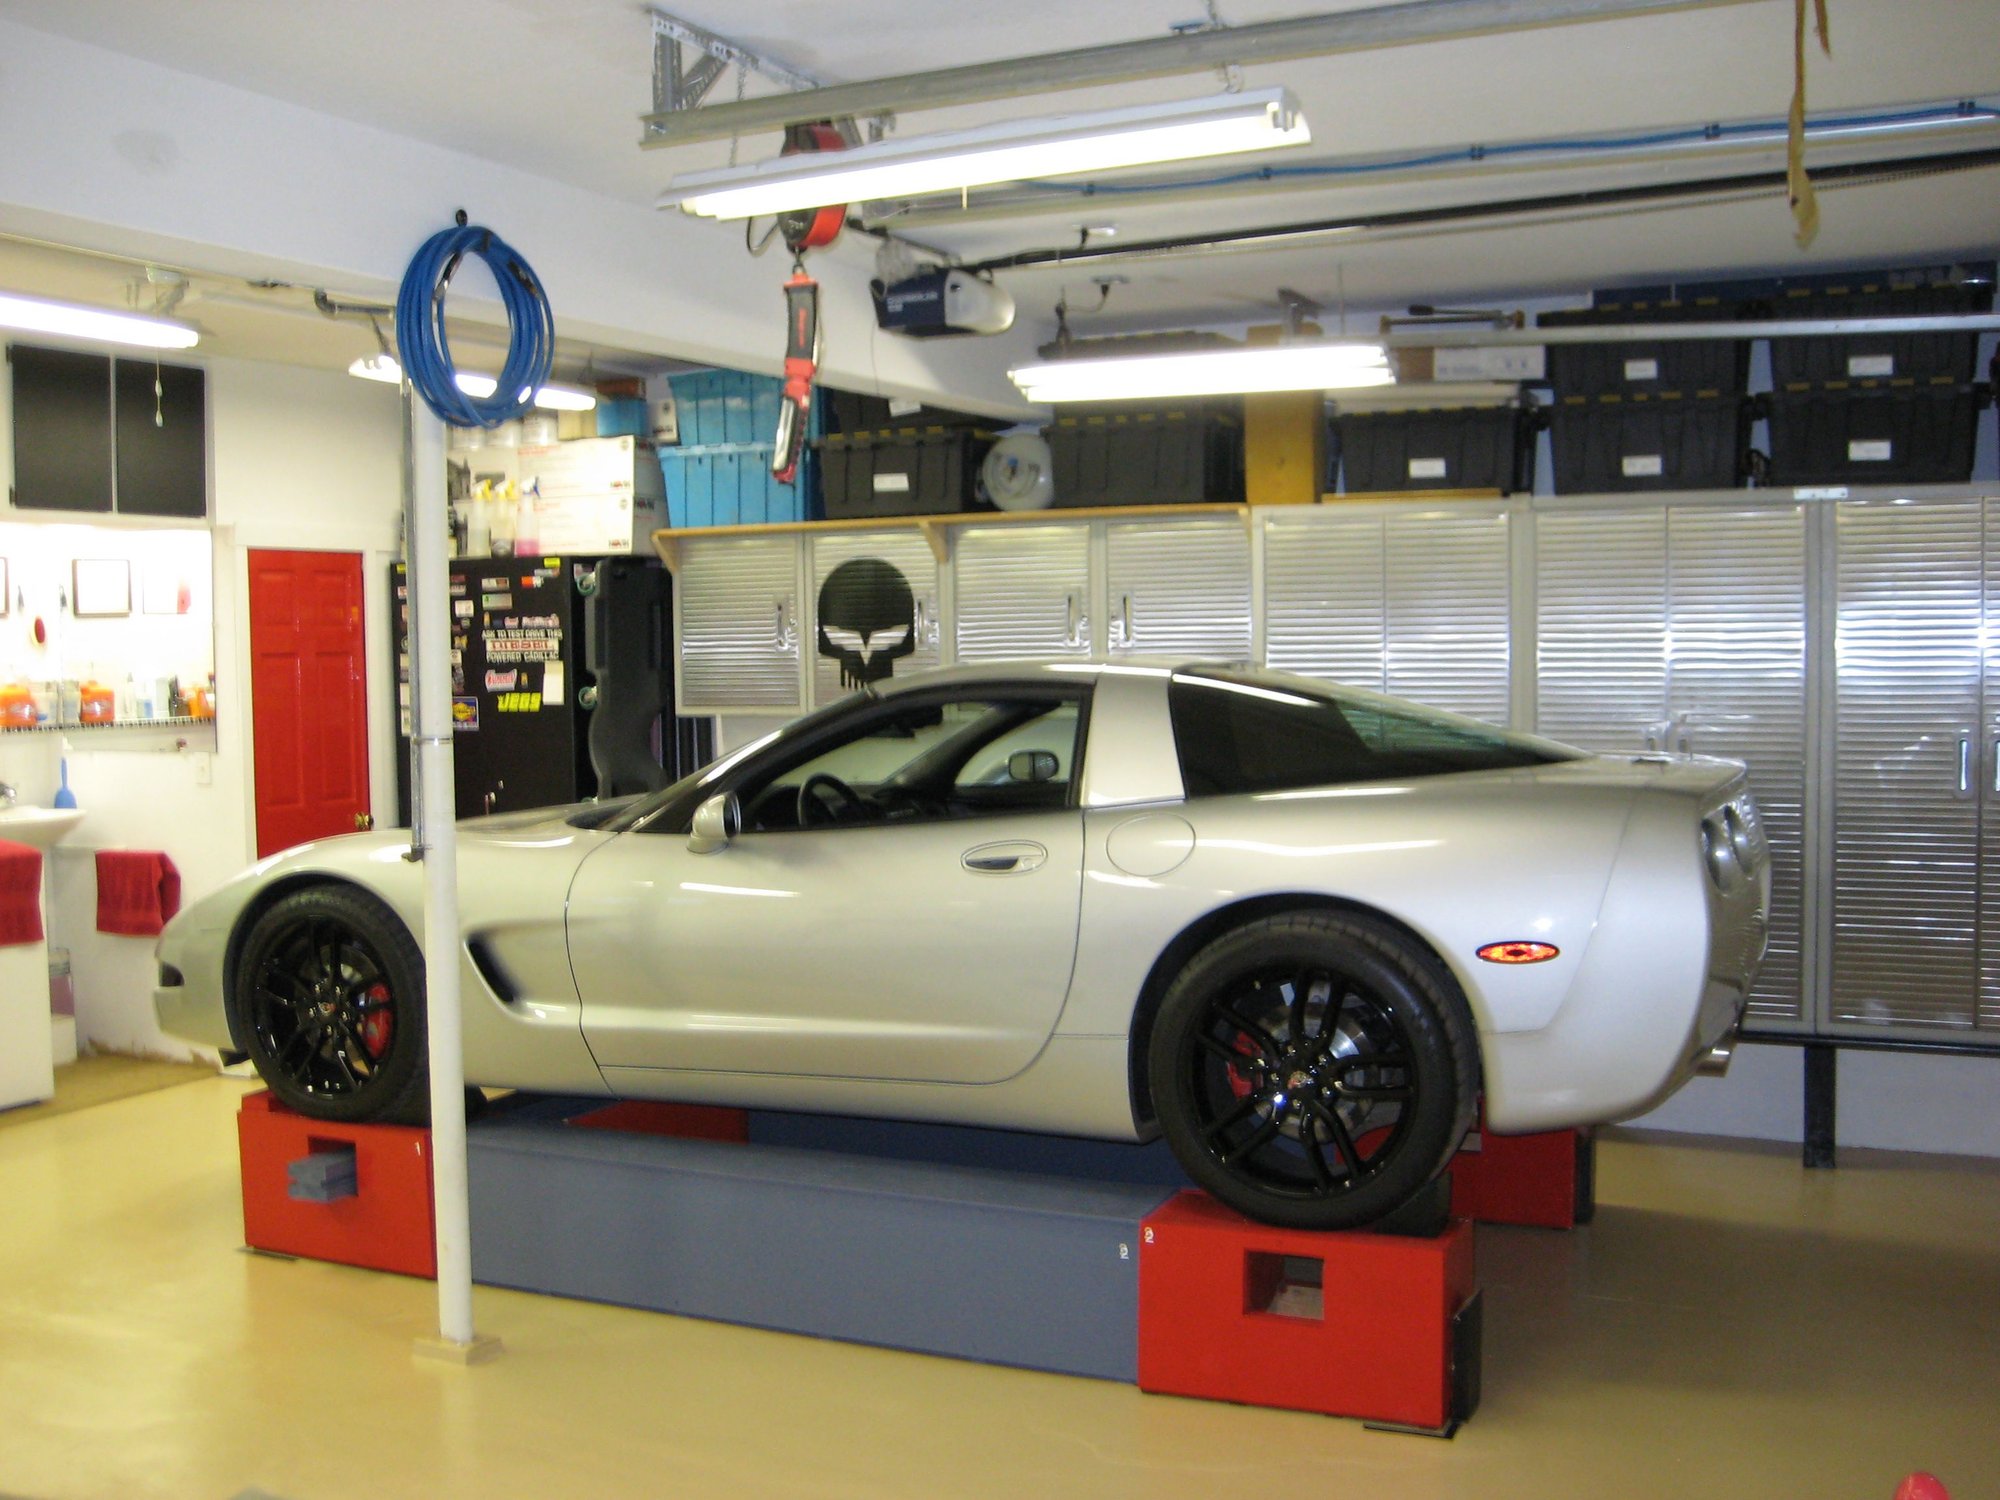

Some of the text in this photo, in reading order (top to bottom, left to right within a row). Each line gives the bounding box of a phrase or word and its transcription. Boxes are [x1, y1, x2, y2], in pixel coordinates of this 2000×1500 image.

[481, 628, 562, 640] ASK TO TEST DRIVE THIS
[486, 650, 559, 663] POWERED CADILLAC
